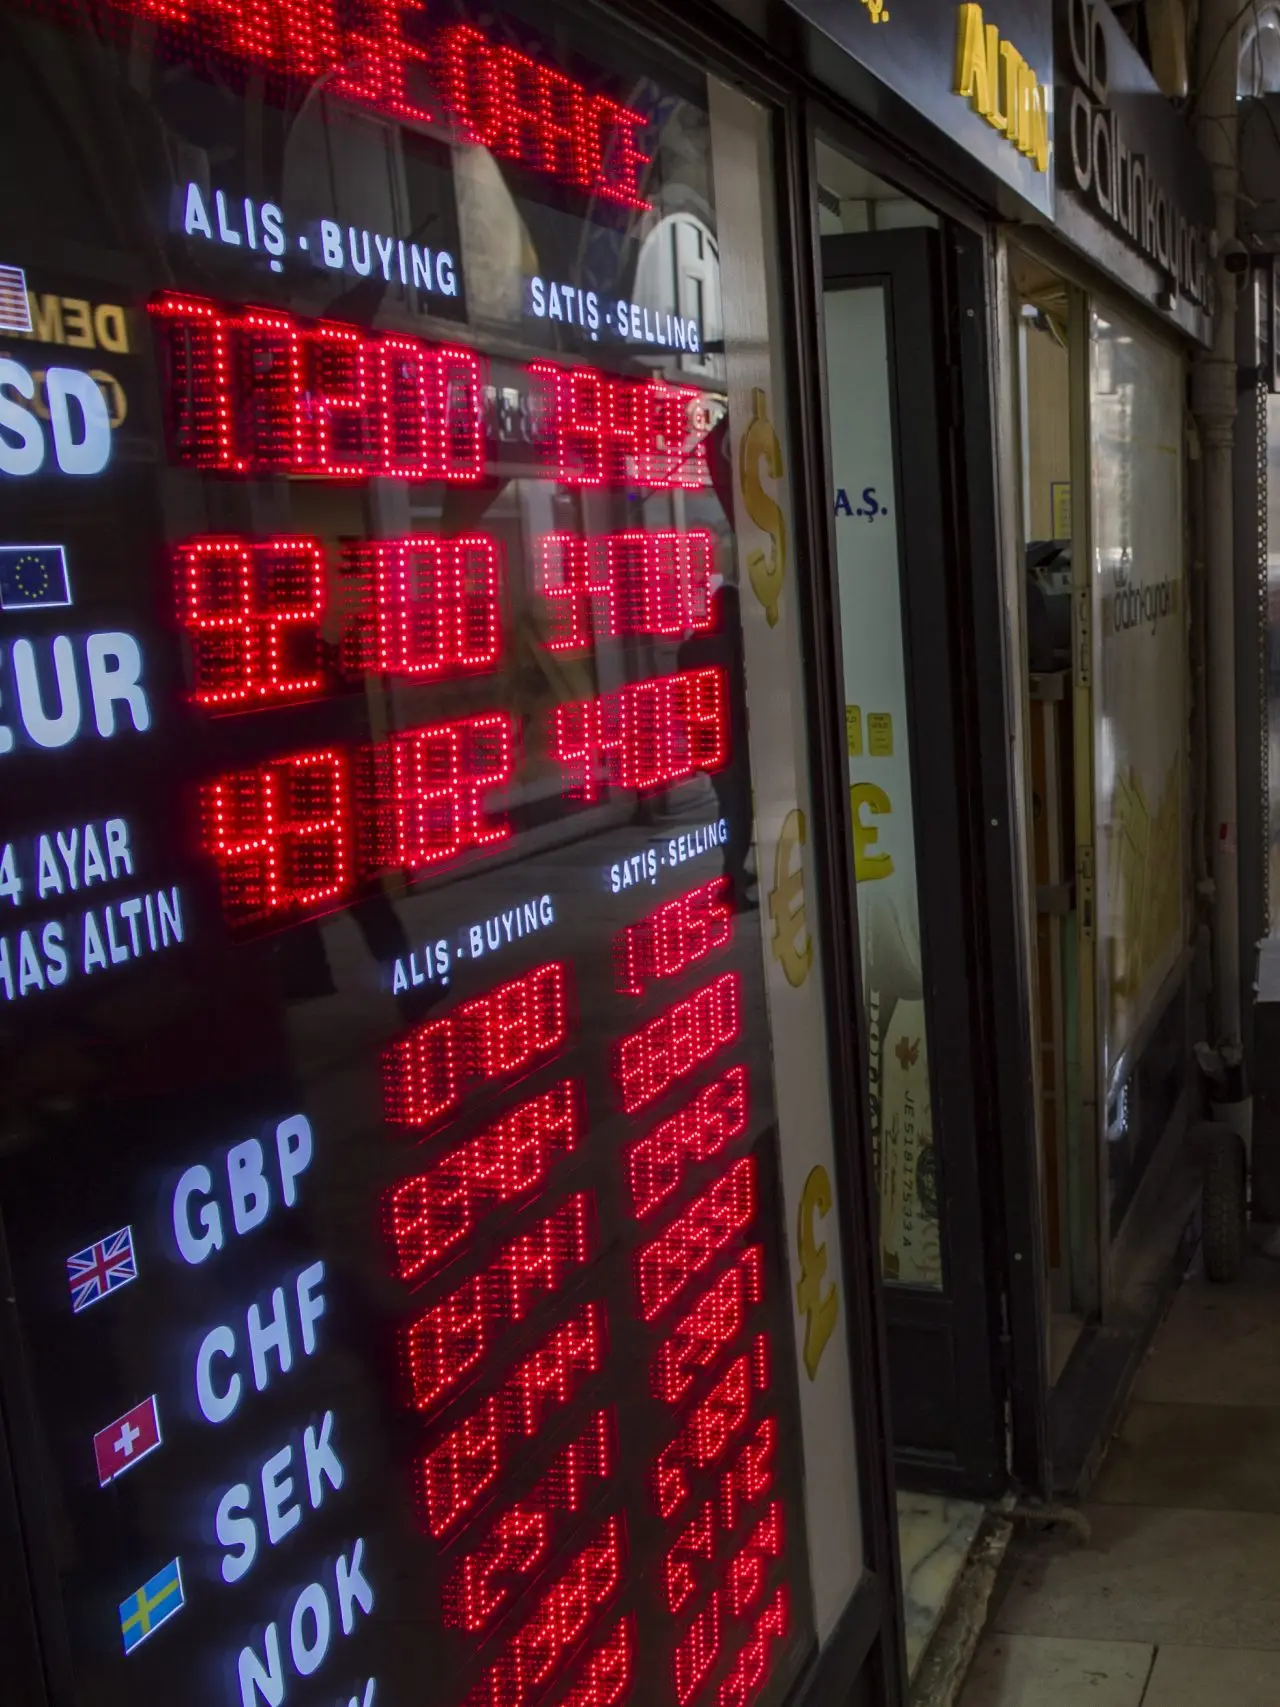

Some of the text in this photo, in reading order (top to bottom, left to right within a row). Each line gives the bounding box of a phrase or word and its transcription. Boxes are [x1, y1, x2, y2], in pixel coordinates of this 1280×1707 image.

[319, 219, 459, 297] BUYING
[616, 293, 700, 353] SELLING
[39, 818, 135, 899] AYAR
[668, 818, 728, 867] SELLING
[84, 886, 185, 975] ALTIN
[469, 894, 555, 959] BUYING
[172, 1113, 313, 1266] GBP
[196, 1259, 326, 1424] CHF
[213, 1410, 345, 1584] SEK
[237, 1537, 374, 1707] NOK
